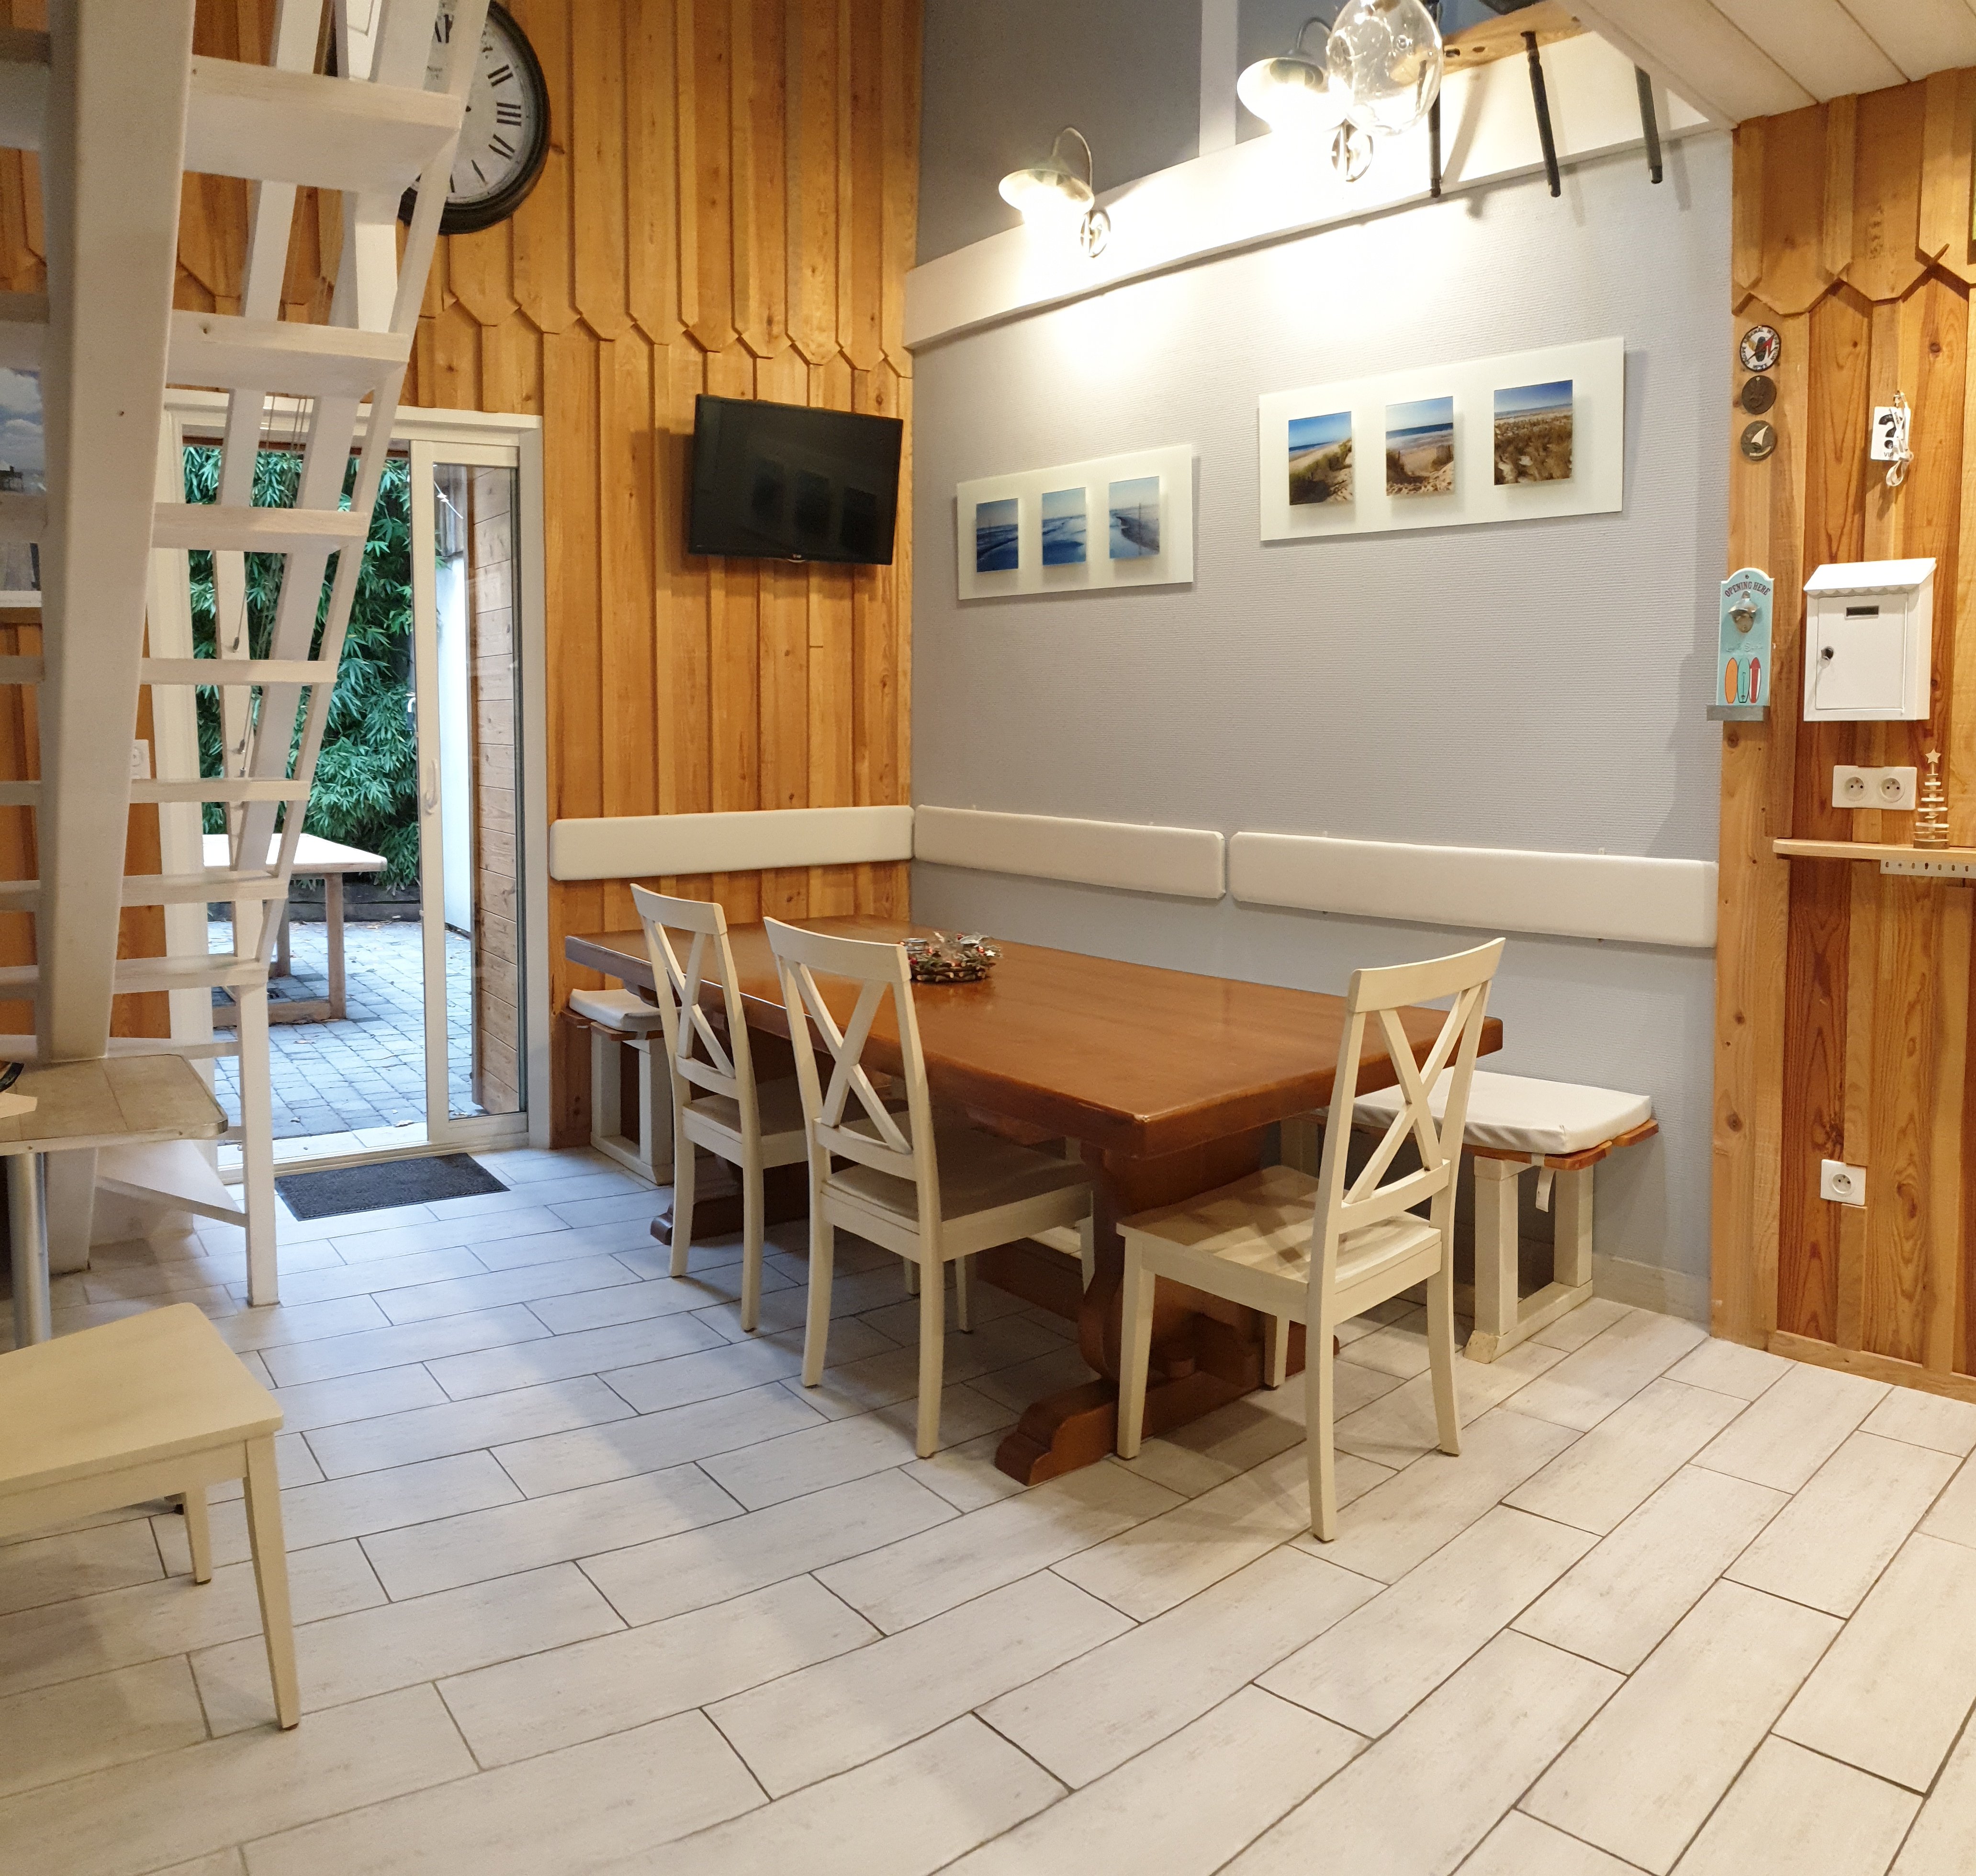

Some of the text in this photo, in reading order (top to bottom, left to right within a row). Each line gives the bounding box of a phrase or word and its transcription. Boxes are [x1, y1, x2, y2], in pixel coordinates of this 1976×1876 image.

[496, 102, 522, 126] III
[1725, 581, 1771, 597] OPENING HERE
